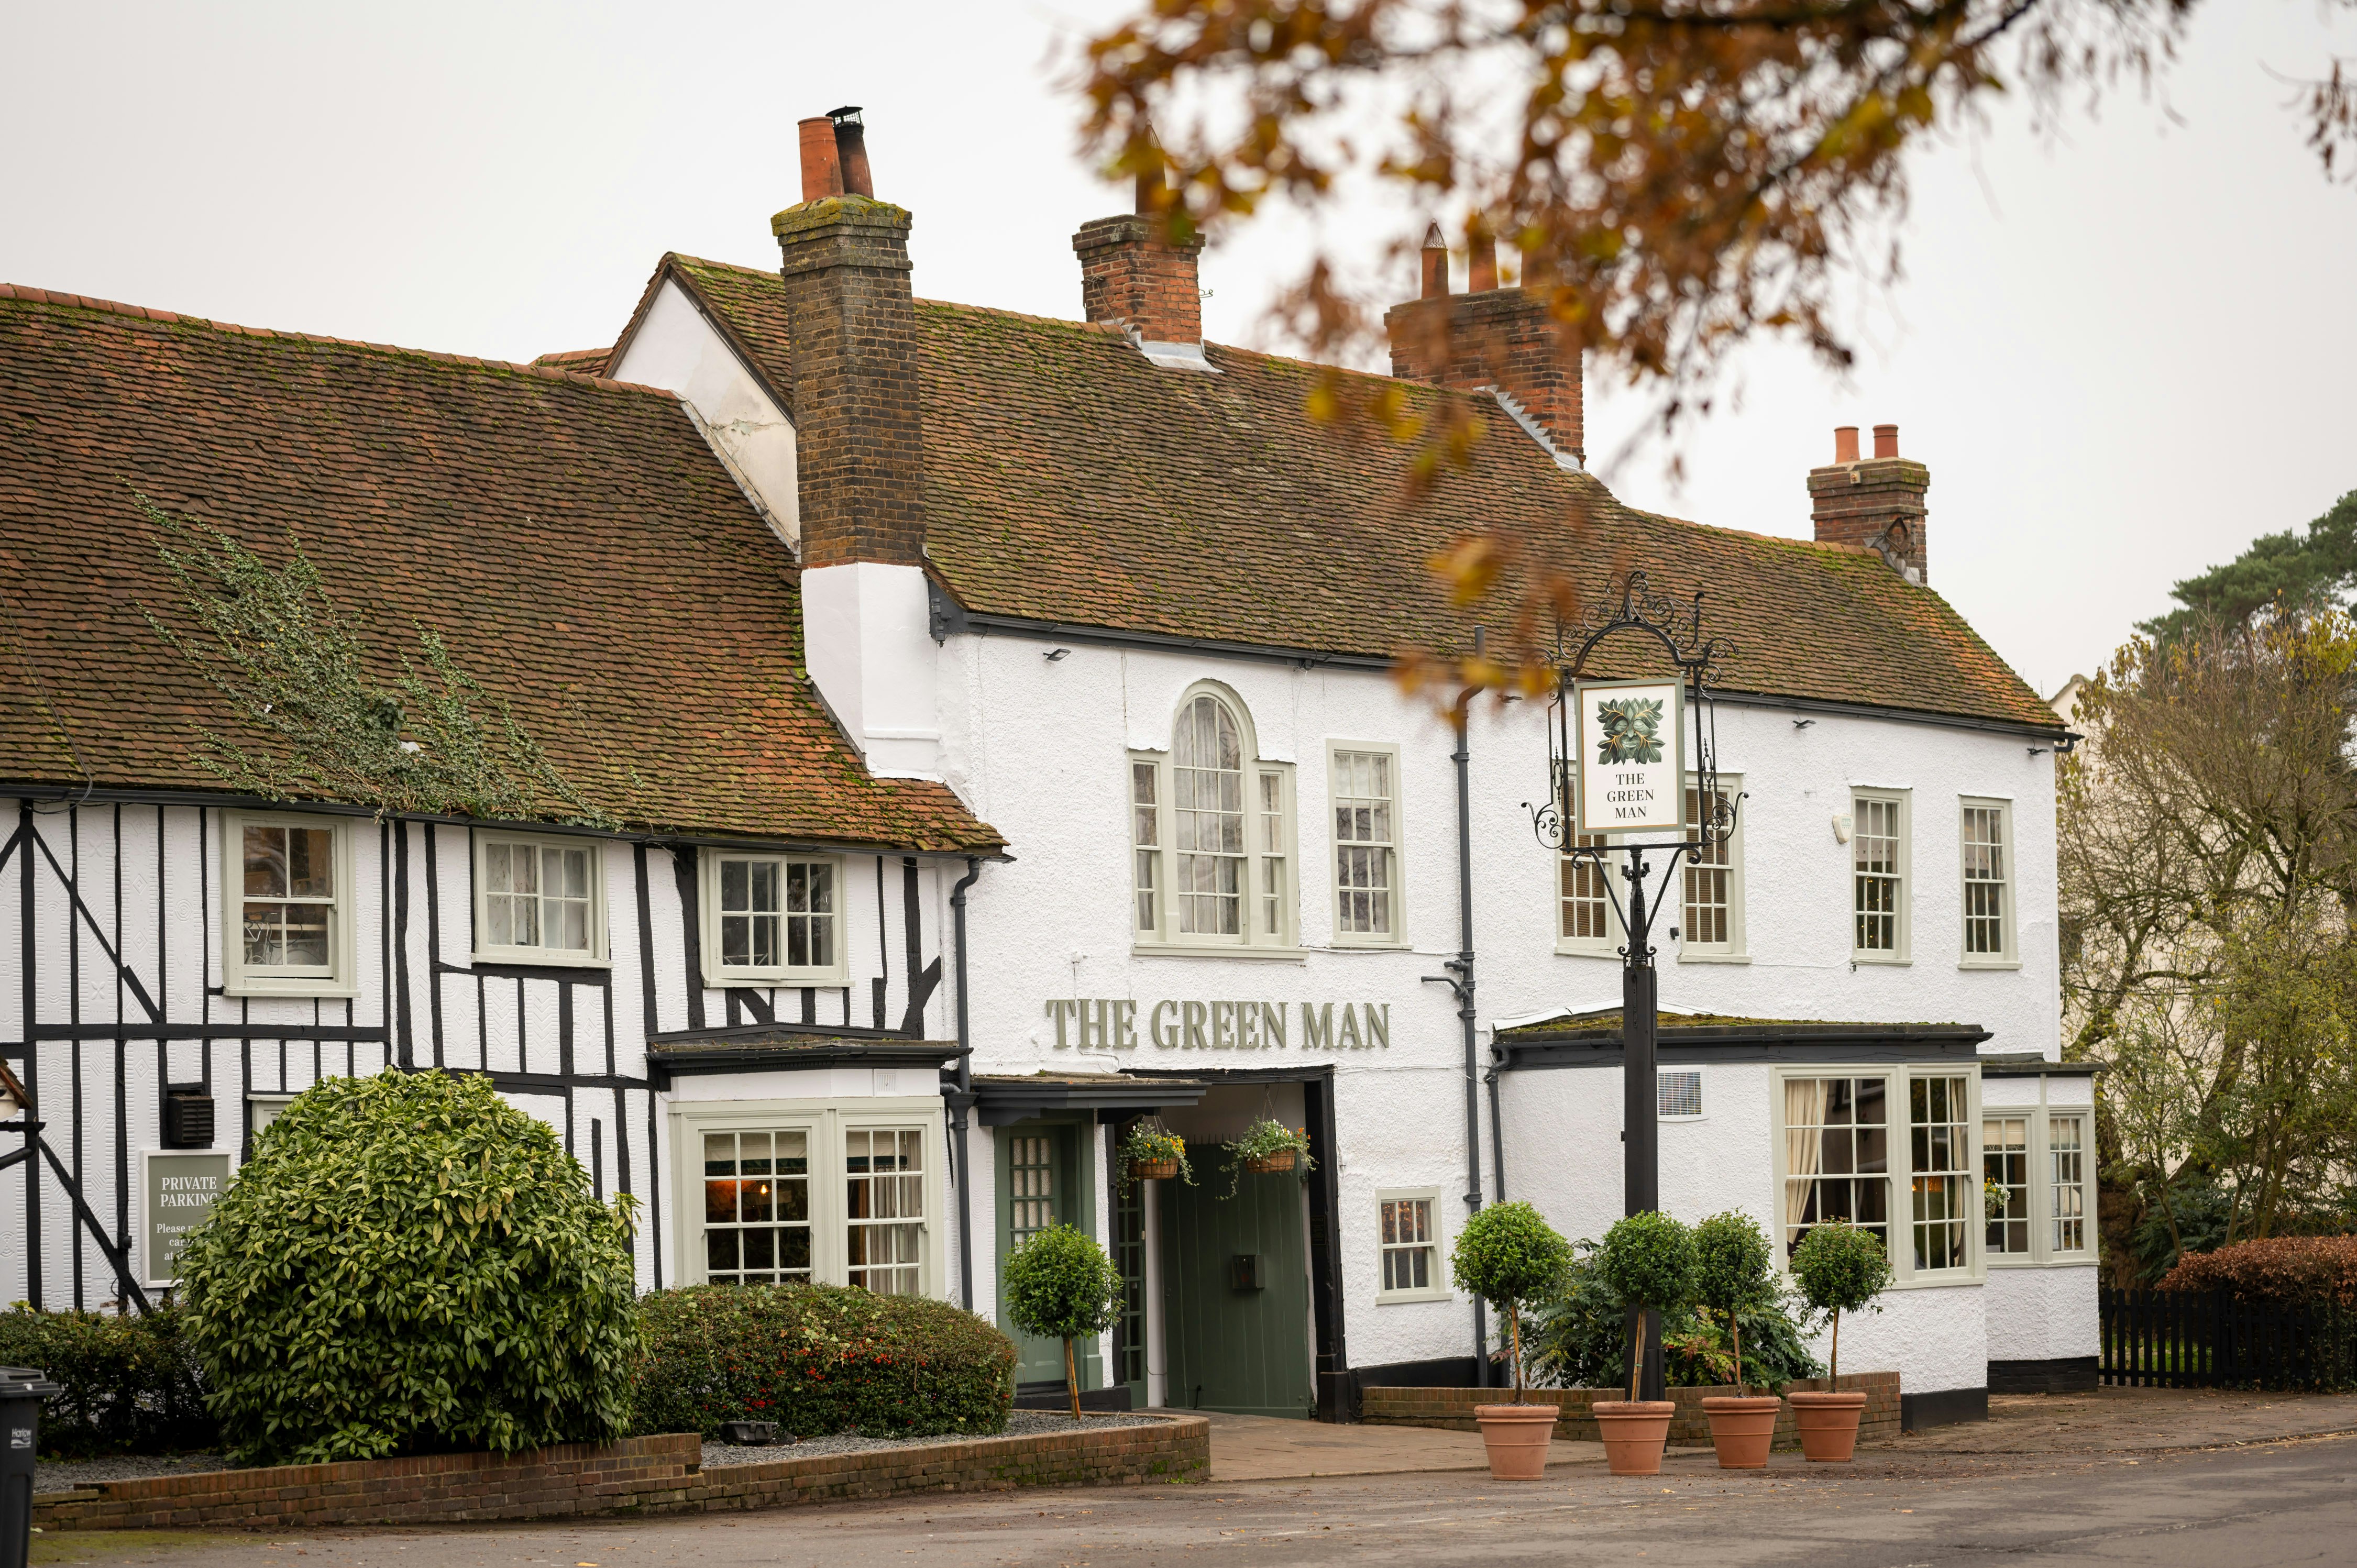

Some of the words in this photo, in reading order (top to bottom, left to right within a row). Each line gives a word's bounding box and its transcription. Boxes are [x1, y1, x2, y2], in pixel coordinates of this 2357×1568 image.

[1616, 773, 1645, 786] THE
[1606, 789, 1654, 802] GREEN
[1615, 807, 1647, 819] MAN
[1046, 998, 1138, 1048] THE
[1151, 999, 1286, 1048] GREEN
[1301, 1001, 1391, 1048] MAN
[161, 1176, 217, 1190] PRIVATE
[157, 1223, 186, 1233] Please
[164, 1250, 174, 1261] at
[12, 1427, 31, 1438] Harlow
